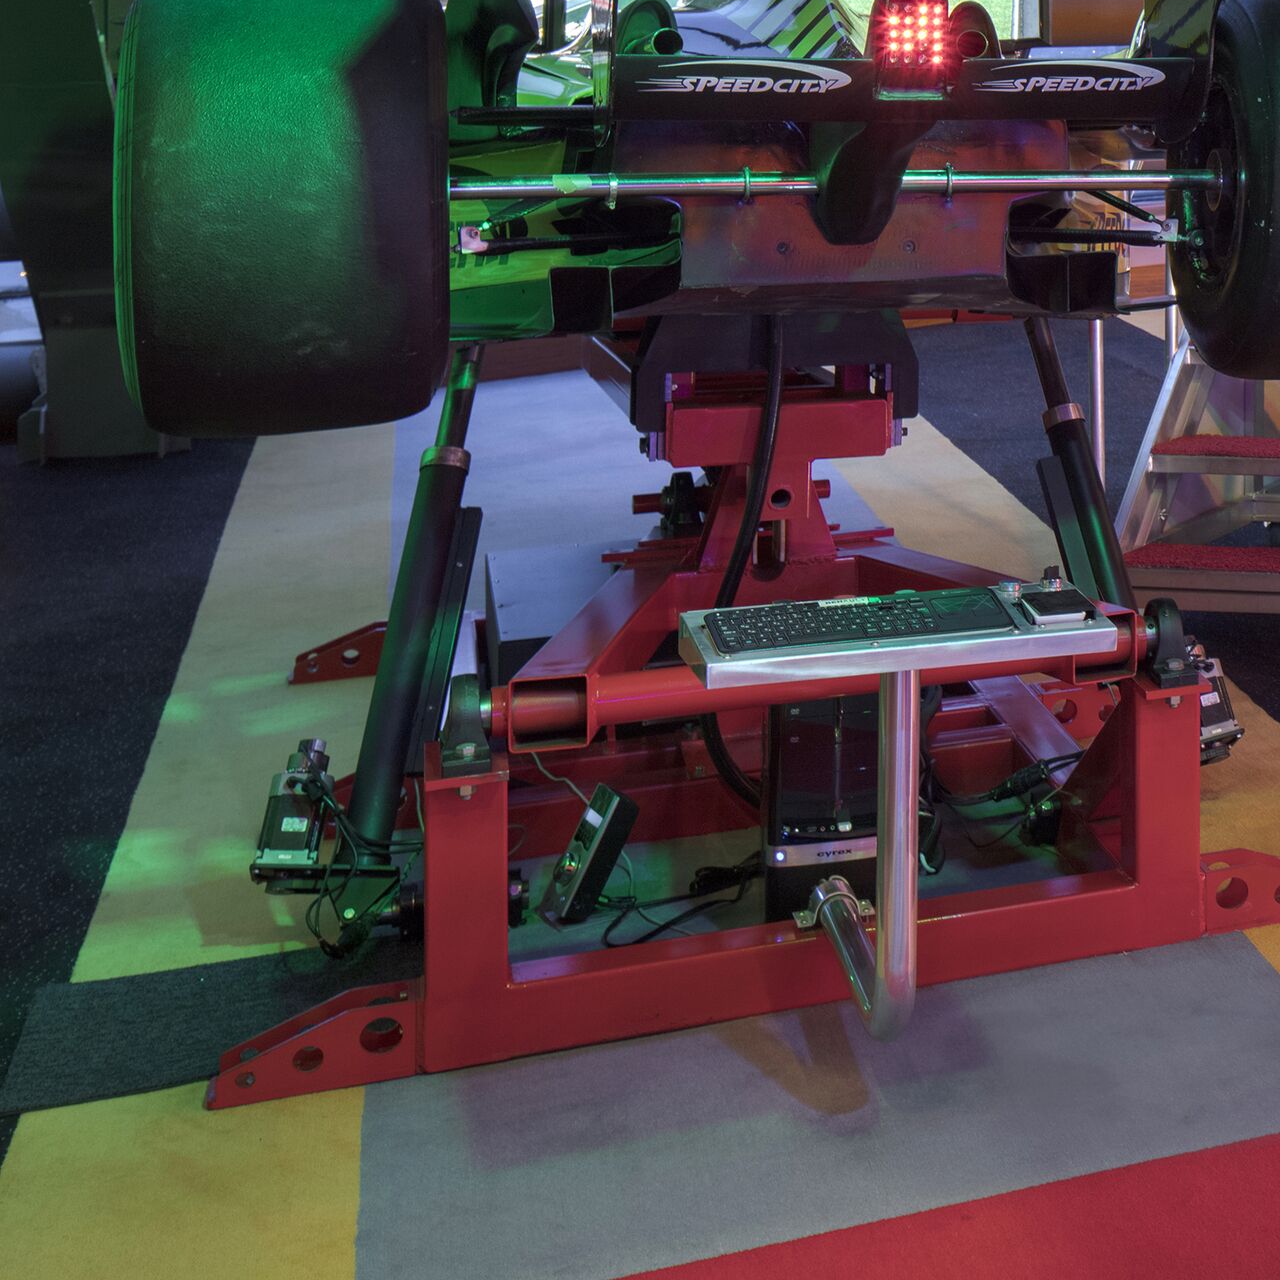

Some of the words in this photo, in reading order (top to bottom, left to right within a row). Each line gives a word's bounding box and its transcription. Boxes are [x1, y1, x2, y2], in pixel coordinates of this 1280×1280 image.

[676, 76, 840, 94] SPEEDCITY
[1010, 76, 1150, 93] SPEEDCITY
[816, 848, 853, 858] cyrex
